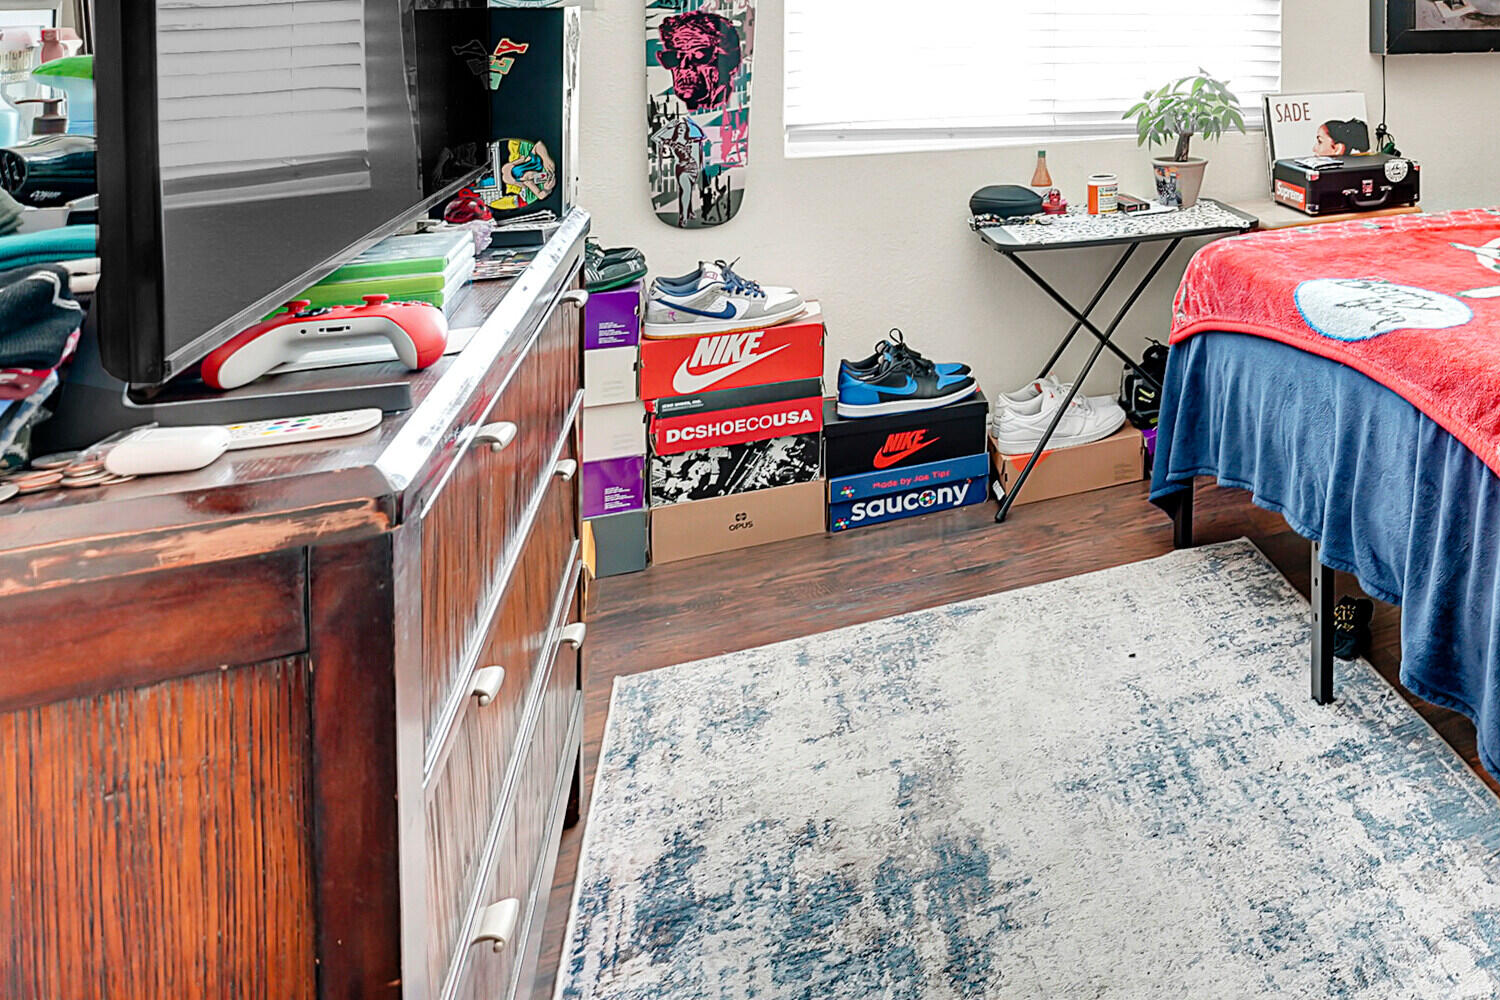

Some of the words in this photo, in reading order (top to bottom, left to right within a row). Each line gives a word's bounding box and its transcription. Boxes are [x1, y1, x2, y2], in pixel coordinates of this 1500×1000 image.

[1275, 102, 1311, 123] SADE
[689, 331, 765, 368] NIKE
[666, 409, 814, 444] DCSHOECOUSA
[882, 429, 928, 453] NIKE
[850, 484, 970, 521] saucony
[729, 521, 753, 532] OPUS
